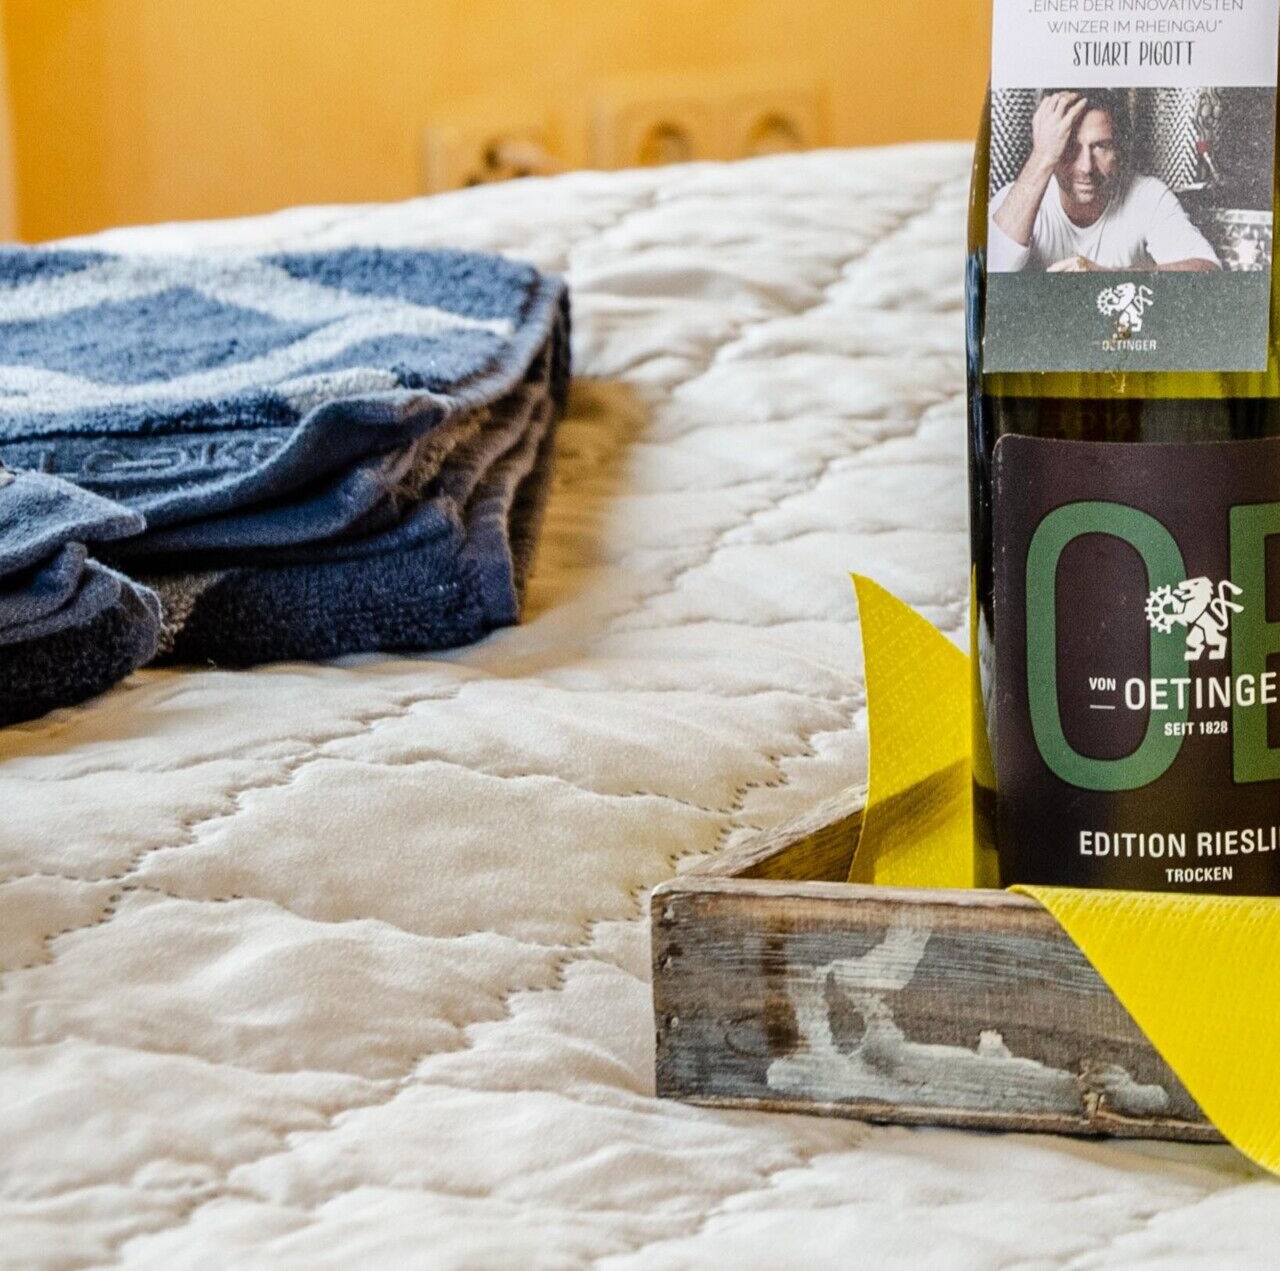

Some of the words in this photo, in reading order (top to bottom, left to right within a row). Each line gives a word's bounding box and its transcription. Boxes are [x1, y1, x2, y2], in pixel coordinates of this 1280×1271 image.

[1047, 20, 1109, 33] WINZER
[1114, 20, 1131, 33] IM
[1072, 41, 1132, 66] STUART
[1139, 40, 1196, 66] PIGOTT
[1089, 677, 1116, 691] VON
[1164, 721, 1193, 736] SEIT
[1199, 720, 1228, 735] 1828
[1079, 829, 1186, 857] EDITION
[1166, 866, 1233, 883] TROCKEN
